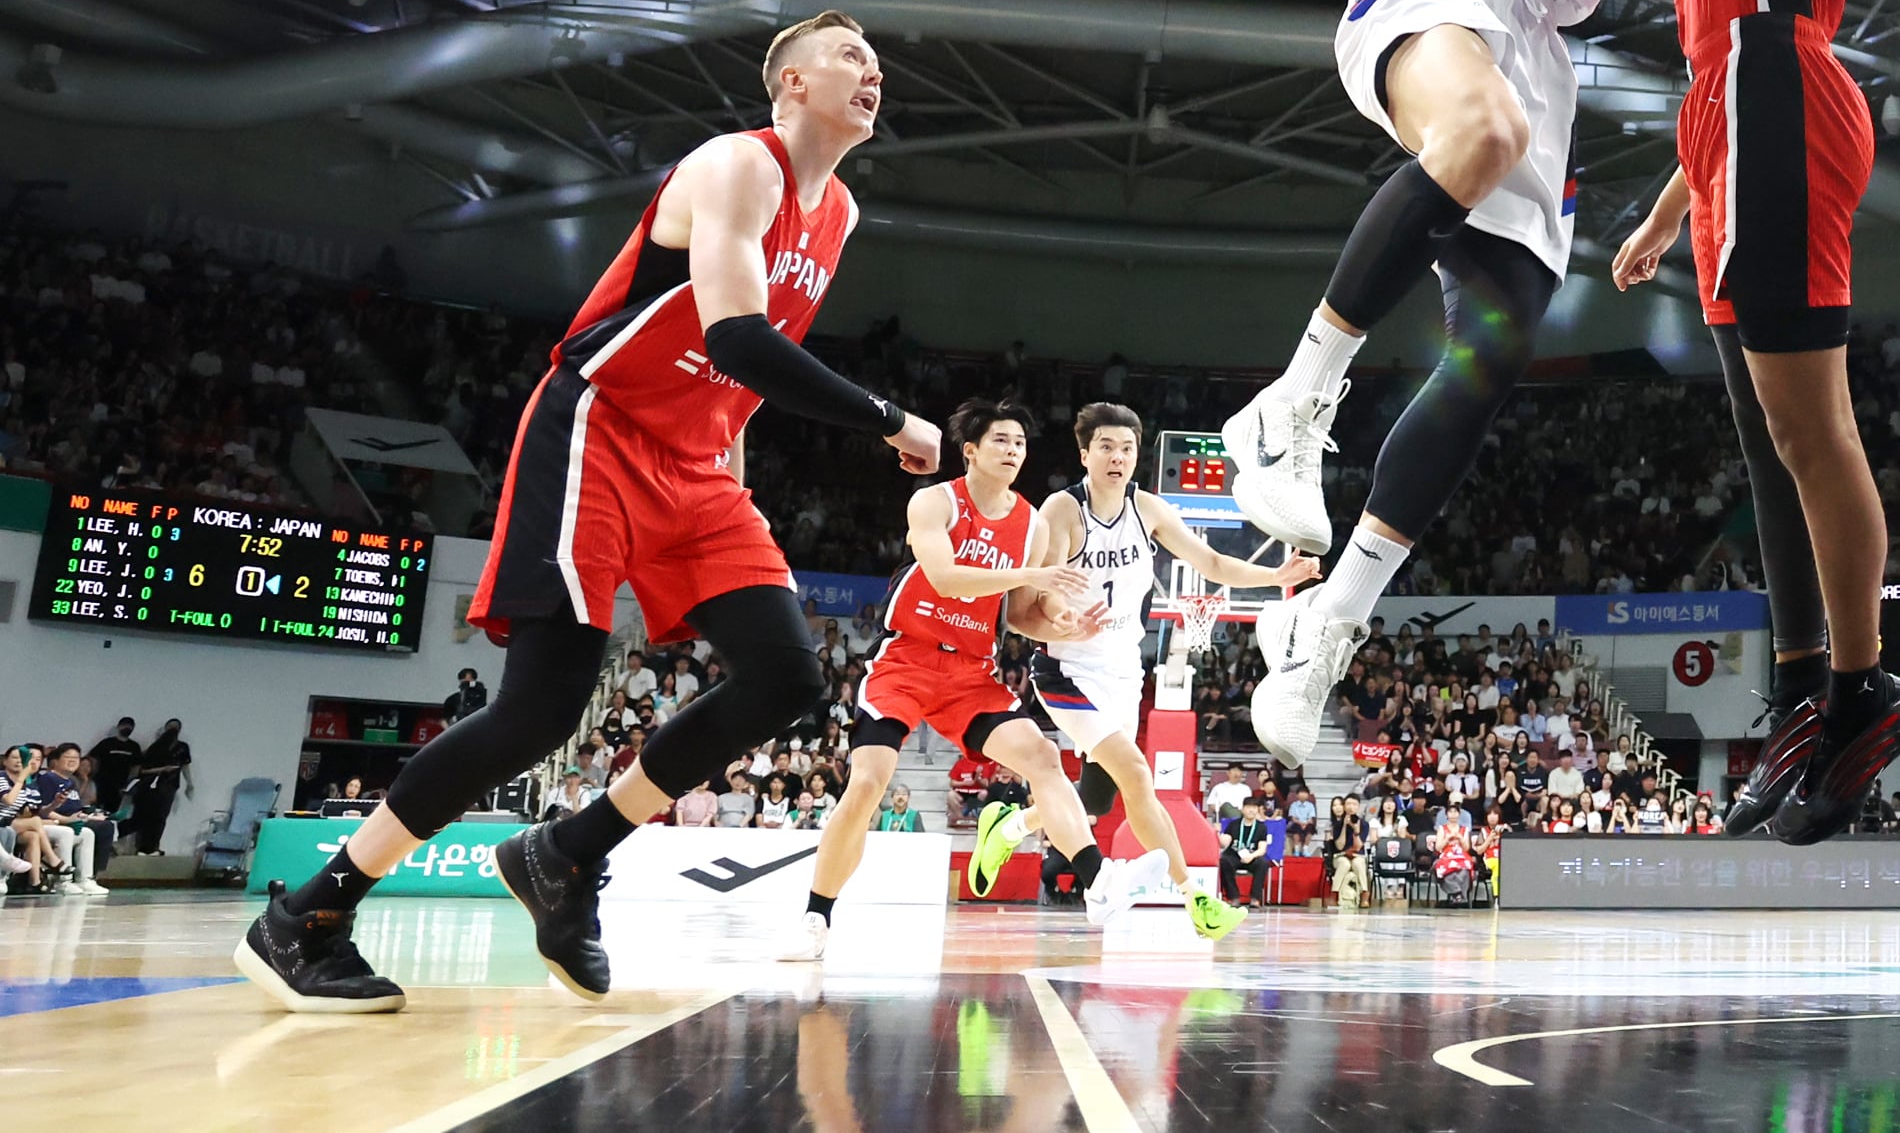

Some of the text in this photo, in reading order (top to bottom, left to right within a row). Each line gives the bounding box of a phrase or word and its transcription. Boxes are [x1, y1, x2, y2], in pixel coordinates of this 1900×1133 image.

[767, 250, 830, 306] JAPAN
[70, 495, 178, 520] NO NAME F P
[77, 516, 179, 541] 1 LEE, H. 0 3
[193, 508, 321, 539] KOREA JAPAN
[71, 537, 157, 559] 8 AN, Y. 0
[239, 535, 282, 557] 7:52
[331, 529, 423, 552] NO NAME F P
[337, 549, 425, 572] 4 JACOBS 0 2
[954, 537, 1014, 569] JAPAN
[1081, 545, 1139, 568] KOREA
[68, 558, 172, 581] 9 LEE, J. 0 3
[189, 564, 204, 586] 6
[335, 567, 342, 580] 7
[345, 568, 385, 587] TOEWS,
[55, 578, 151, 600] 22 YEO, J. 0
[245, 572, 255, 590] 1
[294, 577, 309, 598] 2
[326, 586, 339, 600] 13
[395, 594, 404, 607] 0
[52, 600, 148, 621] 33 LEE, S. 0
[170, 610, 231, 628] T-FOUL 0
[323, 605, 401, 626] 19 NISHIDA 0
[934, 607, 989, 634] SoftBank
[1634, 606, 1719, 622] 아이에스동서
[273, 621, 315, 637] T-FOUL
[318, 625, 333, 638] 24
[390, 632, 398, 645] 0
[1685, 651, 1700, 677] 5
[396, 843, 500, 878] 나은행
